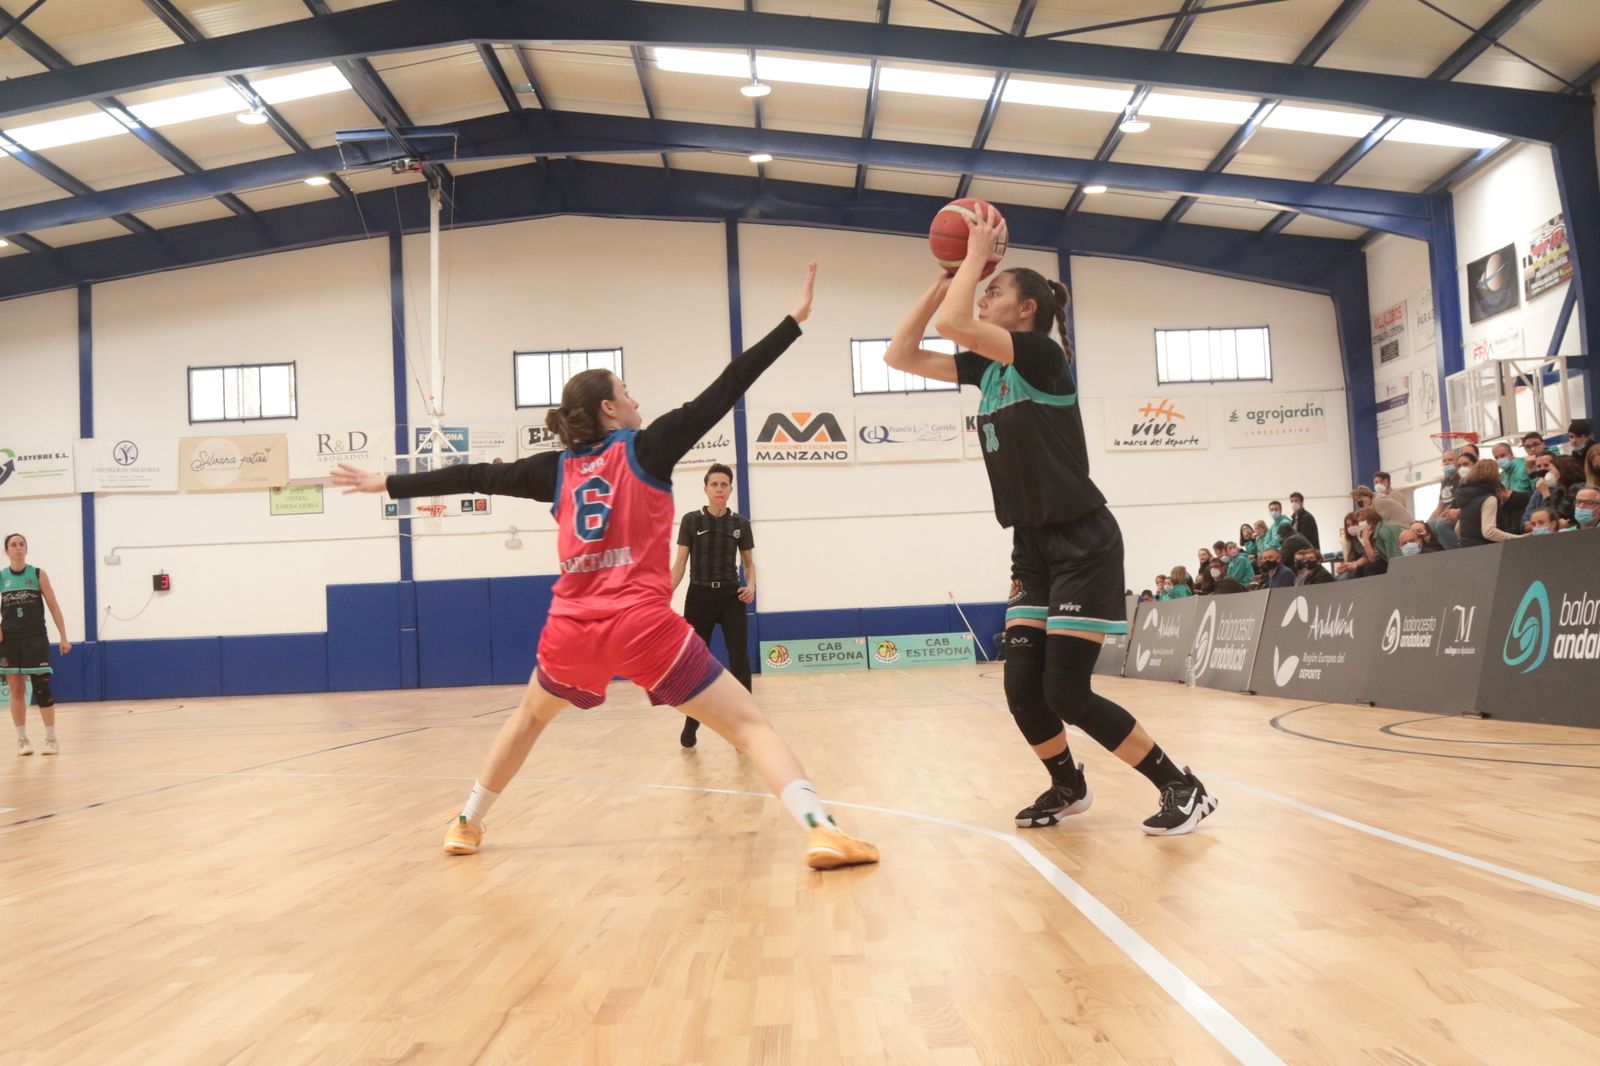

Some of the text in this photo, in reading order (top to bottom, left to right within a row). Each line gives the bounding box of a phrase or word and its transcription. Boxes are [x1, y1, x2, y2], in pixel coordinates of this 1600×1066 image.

[1246, 402, 1323, 425] agrojardín
[931, 424, 957, 432] Garrido
[1245, 428, 1310, 436] LANDSCAPING
[316, 431, 368, 454] R&D
[1114, 438, 1120, 446] la
[1150, 438, 1162, 446] del
[1165, 437, 1200, 447] deporte
[191, 450, 237, 472] Silvana
[317, 453, 369, 464] ABOGADOS
[756, 451, 848, 461] MANZANO
[573, 476, 613, 542] 6
[17, 607, 24, 618] 5
[1403, 616, 1437, 632] baloncesto
[817, 642, 842, 651] CAB
[925, 638, 950, 647] CAB
[798, 651, 864, 663] ESTEPONA
[906, 647, 972, 657] ESTEPONA
